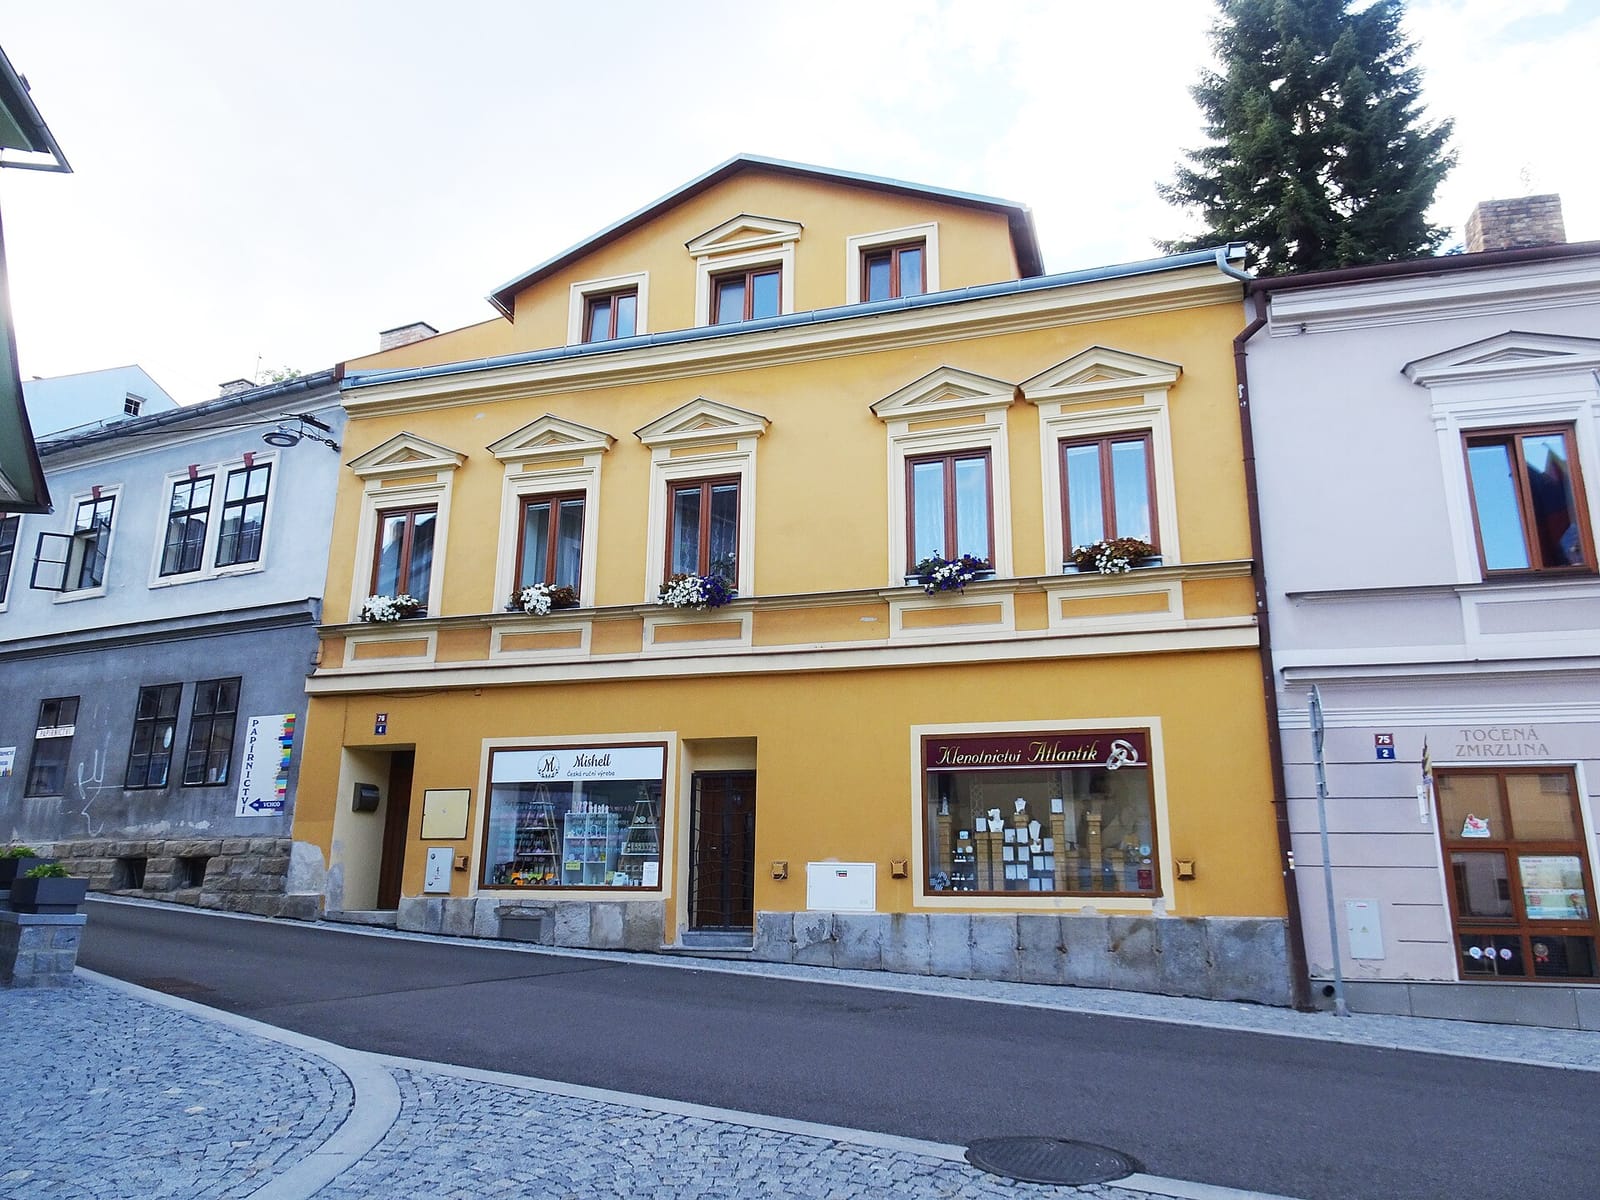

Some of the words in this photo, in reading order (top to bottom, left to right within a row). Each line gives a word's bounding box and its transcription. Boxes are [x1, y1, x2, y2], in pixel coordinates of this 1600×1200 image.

[1377, 736, 1391, 744] 75
[1460, 725, 1540, 742] TOČENÁ
[1027, 739, 1100, 762] Atlantik
[1382, 749, 1390, 757] 2
[1455, 743, 1550, 758] ZMRZLINA
[241, 719, 259, 814] PAPÍRNICTVÍ
[541, 756, 557, 772] M
[573, 753, 612, 768] Mishell
